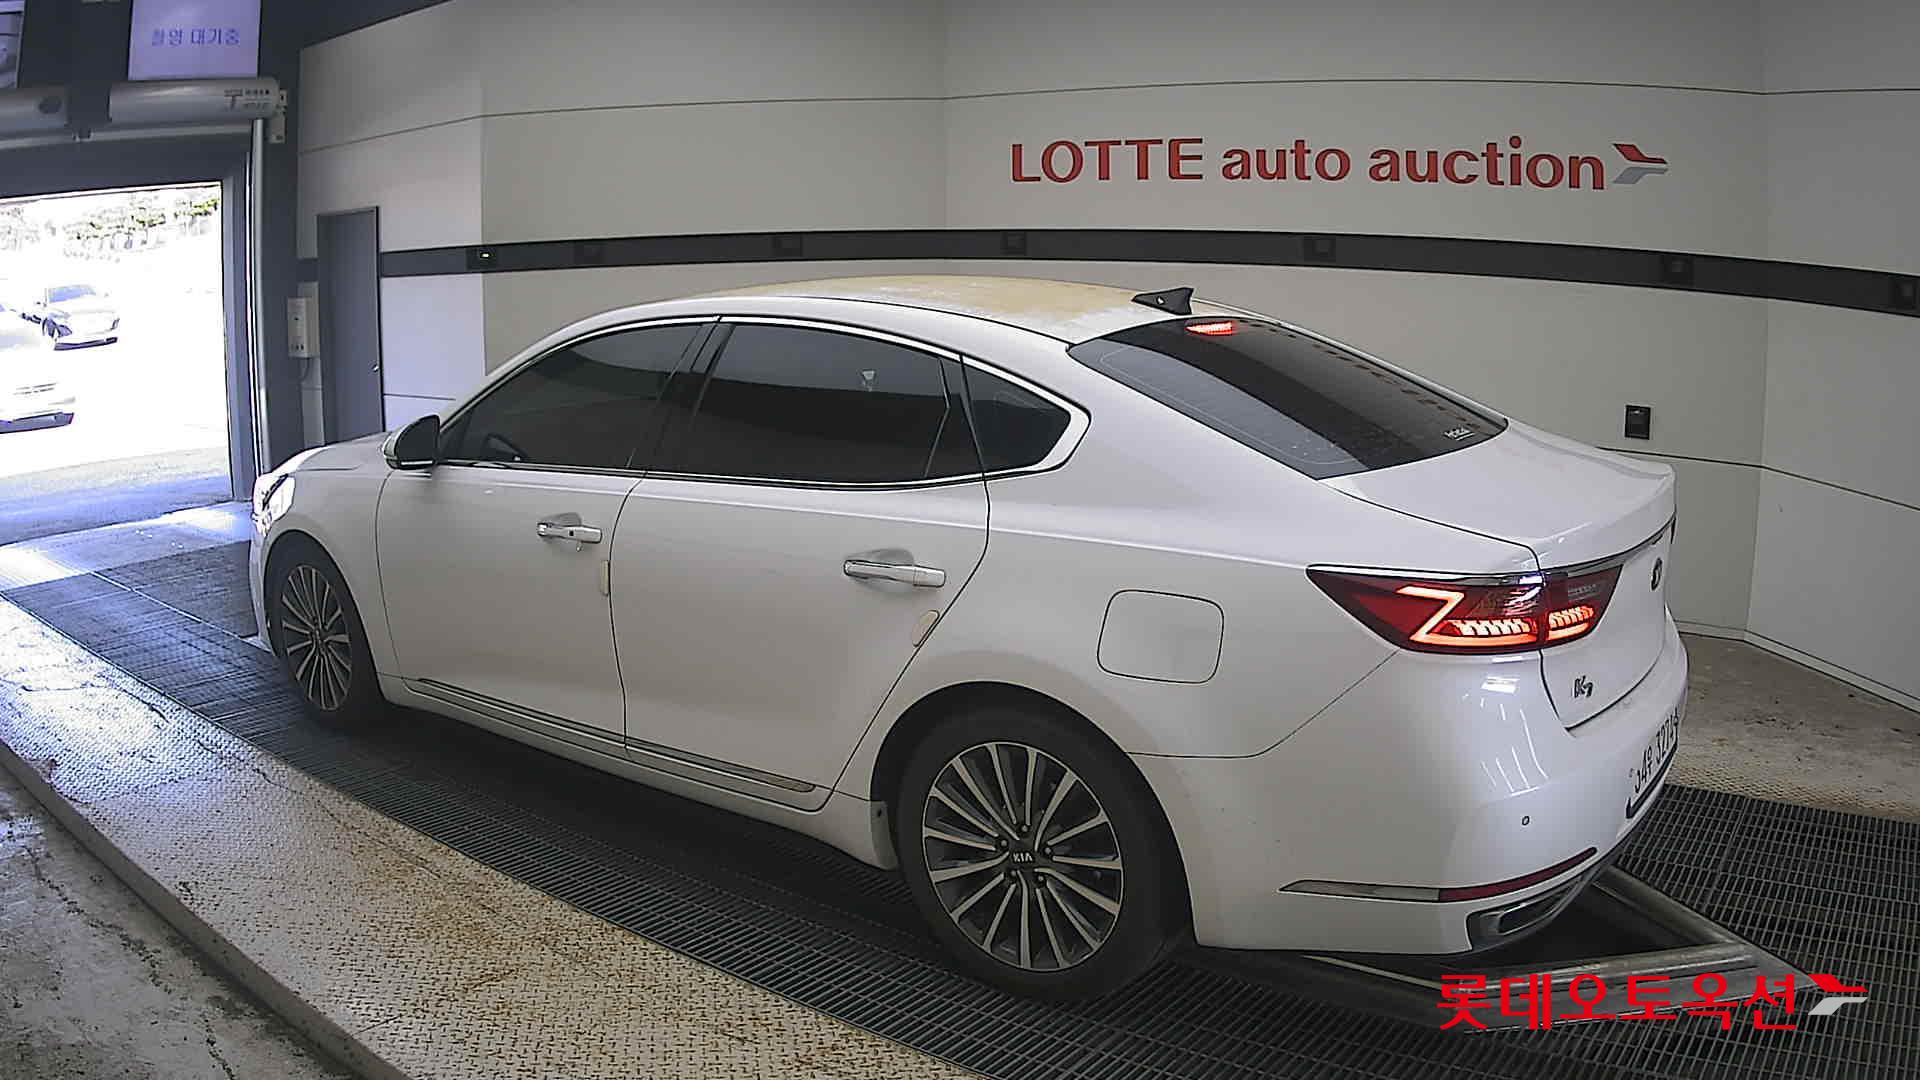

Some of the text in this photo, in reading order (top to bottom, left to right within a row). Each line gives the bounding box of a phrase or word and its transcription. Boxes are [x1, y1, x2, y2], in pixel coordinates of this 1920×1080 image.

[1011, 135, 1605, 190] LOTTE auto auction
[1012, 852, 1033, 862] KIA
